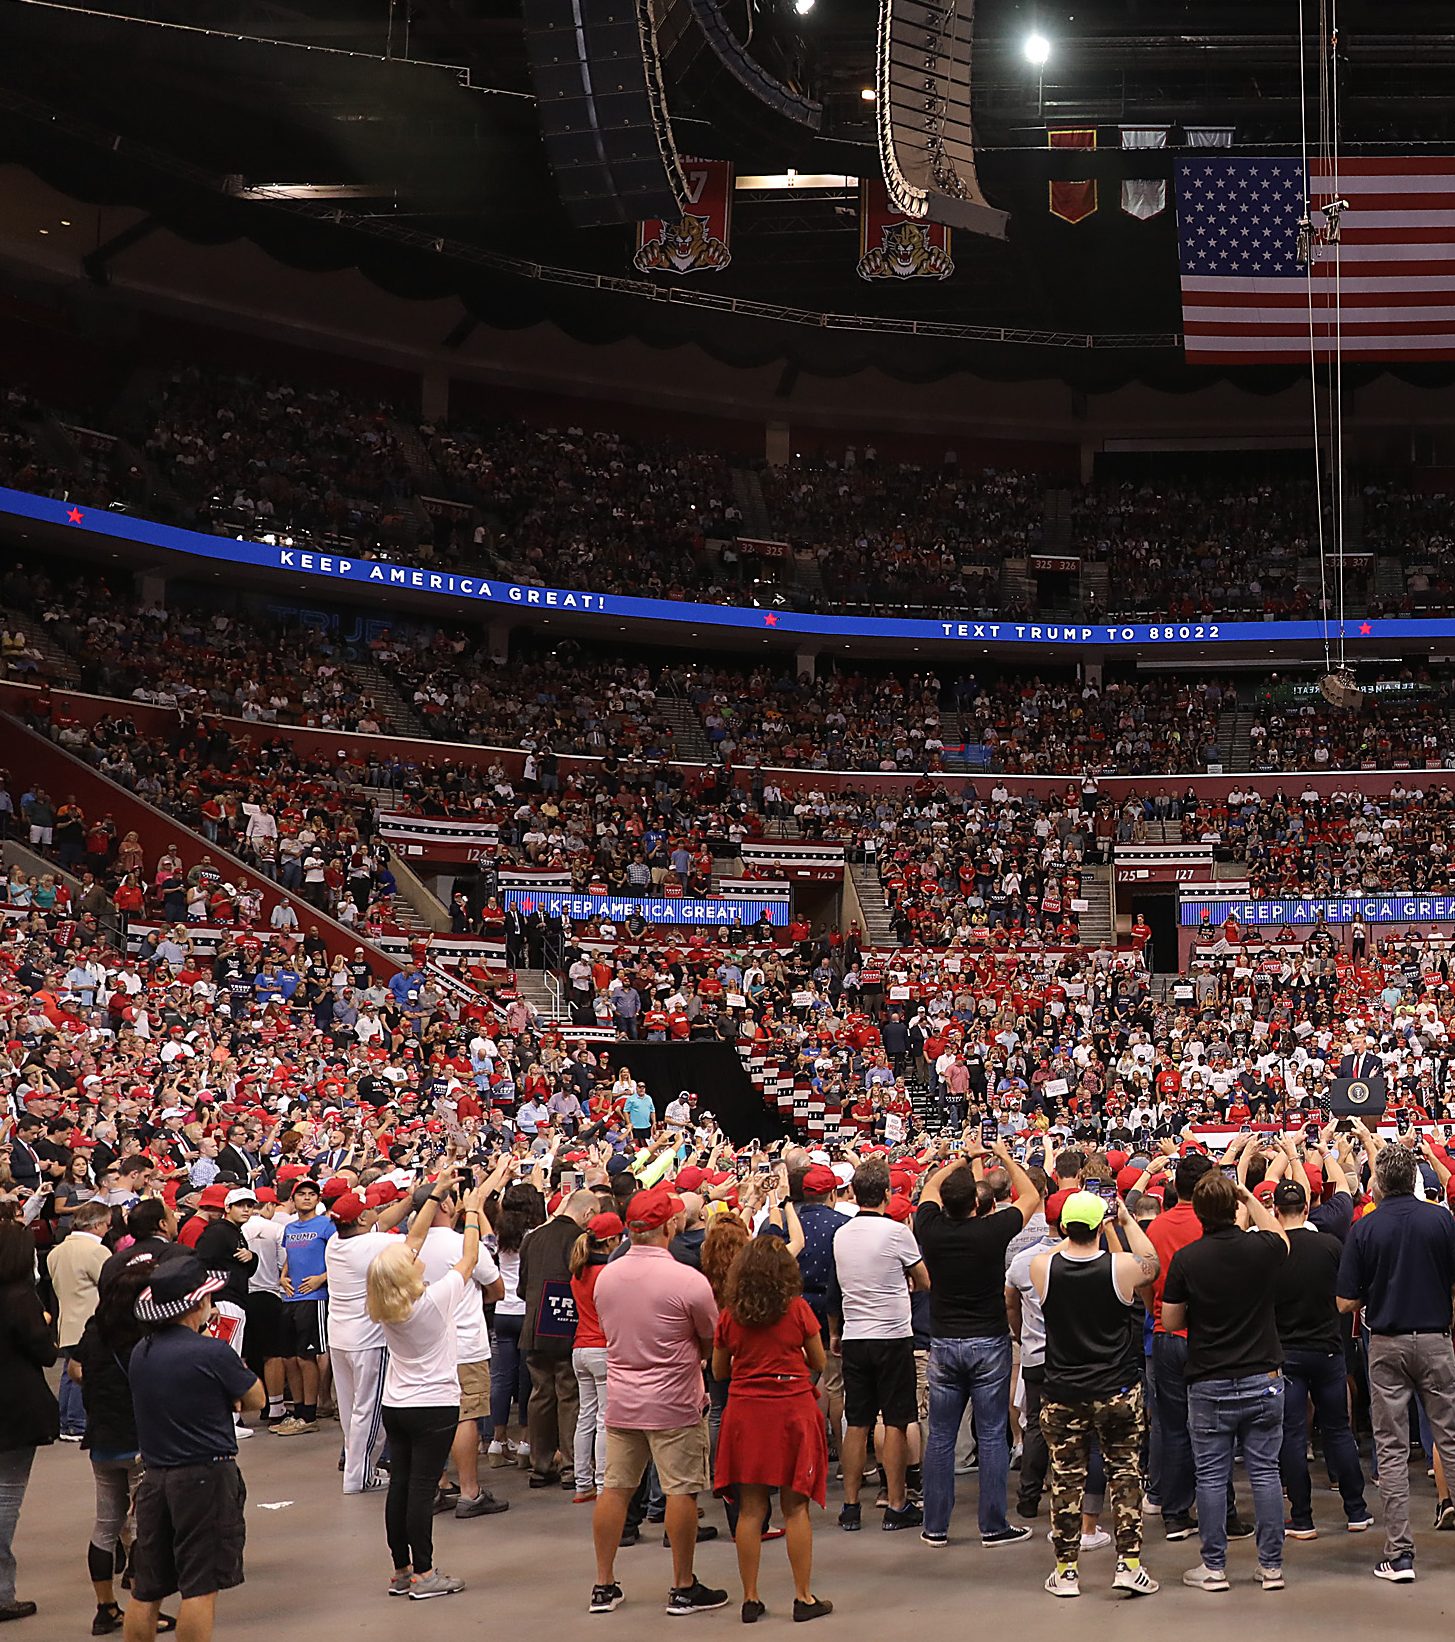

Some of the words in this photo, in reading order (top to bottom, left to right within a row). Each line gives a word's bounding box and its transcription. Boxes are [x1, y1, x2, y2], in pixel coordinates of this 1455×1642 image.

[766, 546, 783, 557] 325
[1035, 560, 1052, 570] 325
[1059, 561, 1076, 571] 326
[280, 551, 352, 574] KEEP
[369, 563, 492, 597] AMERICA
[508, 588, 604, 610] GREAT!
[941, 623, 1000, 638] TEXT
[1015, 625, 1092, 640] TRUMP
[1106, 626, 1135, 641] TO
[1149, 625, 1219, 640] 88022
[1118, 870, 1136, 882] 125
[1175, 869, 1194, 880] 127
[550, 900, 593, 914] KEEP
[600, 903, 675, 918] AMERICA
[682, 906, 742, 920] GREAT!
[1230, 905, 1283, 920] KEEP
[1294, 903, 1393, 918] AMERICA
[285, 1232, 318, 1243] TRUMP
